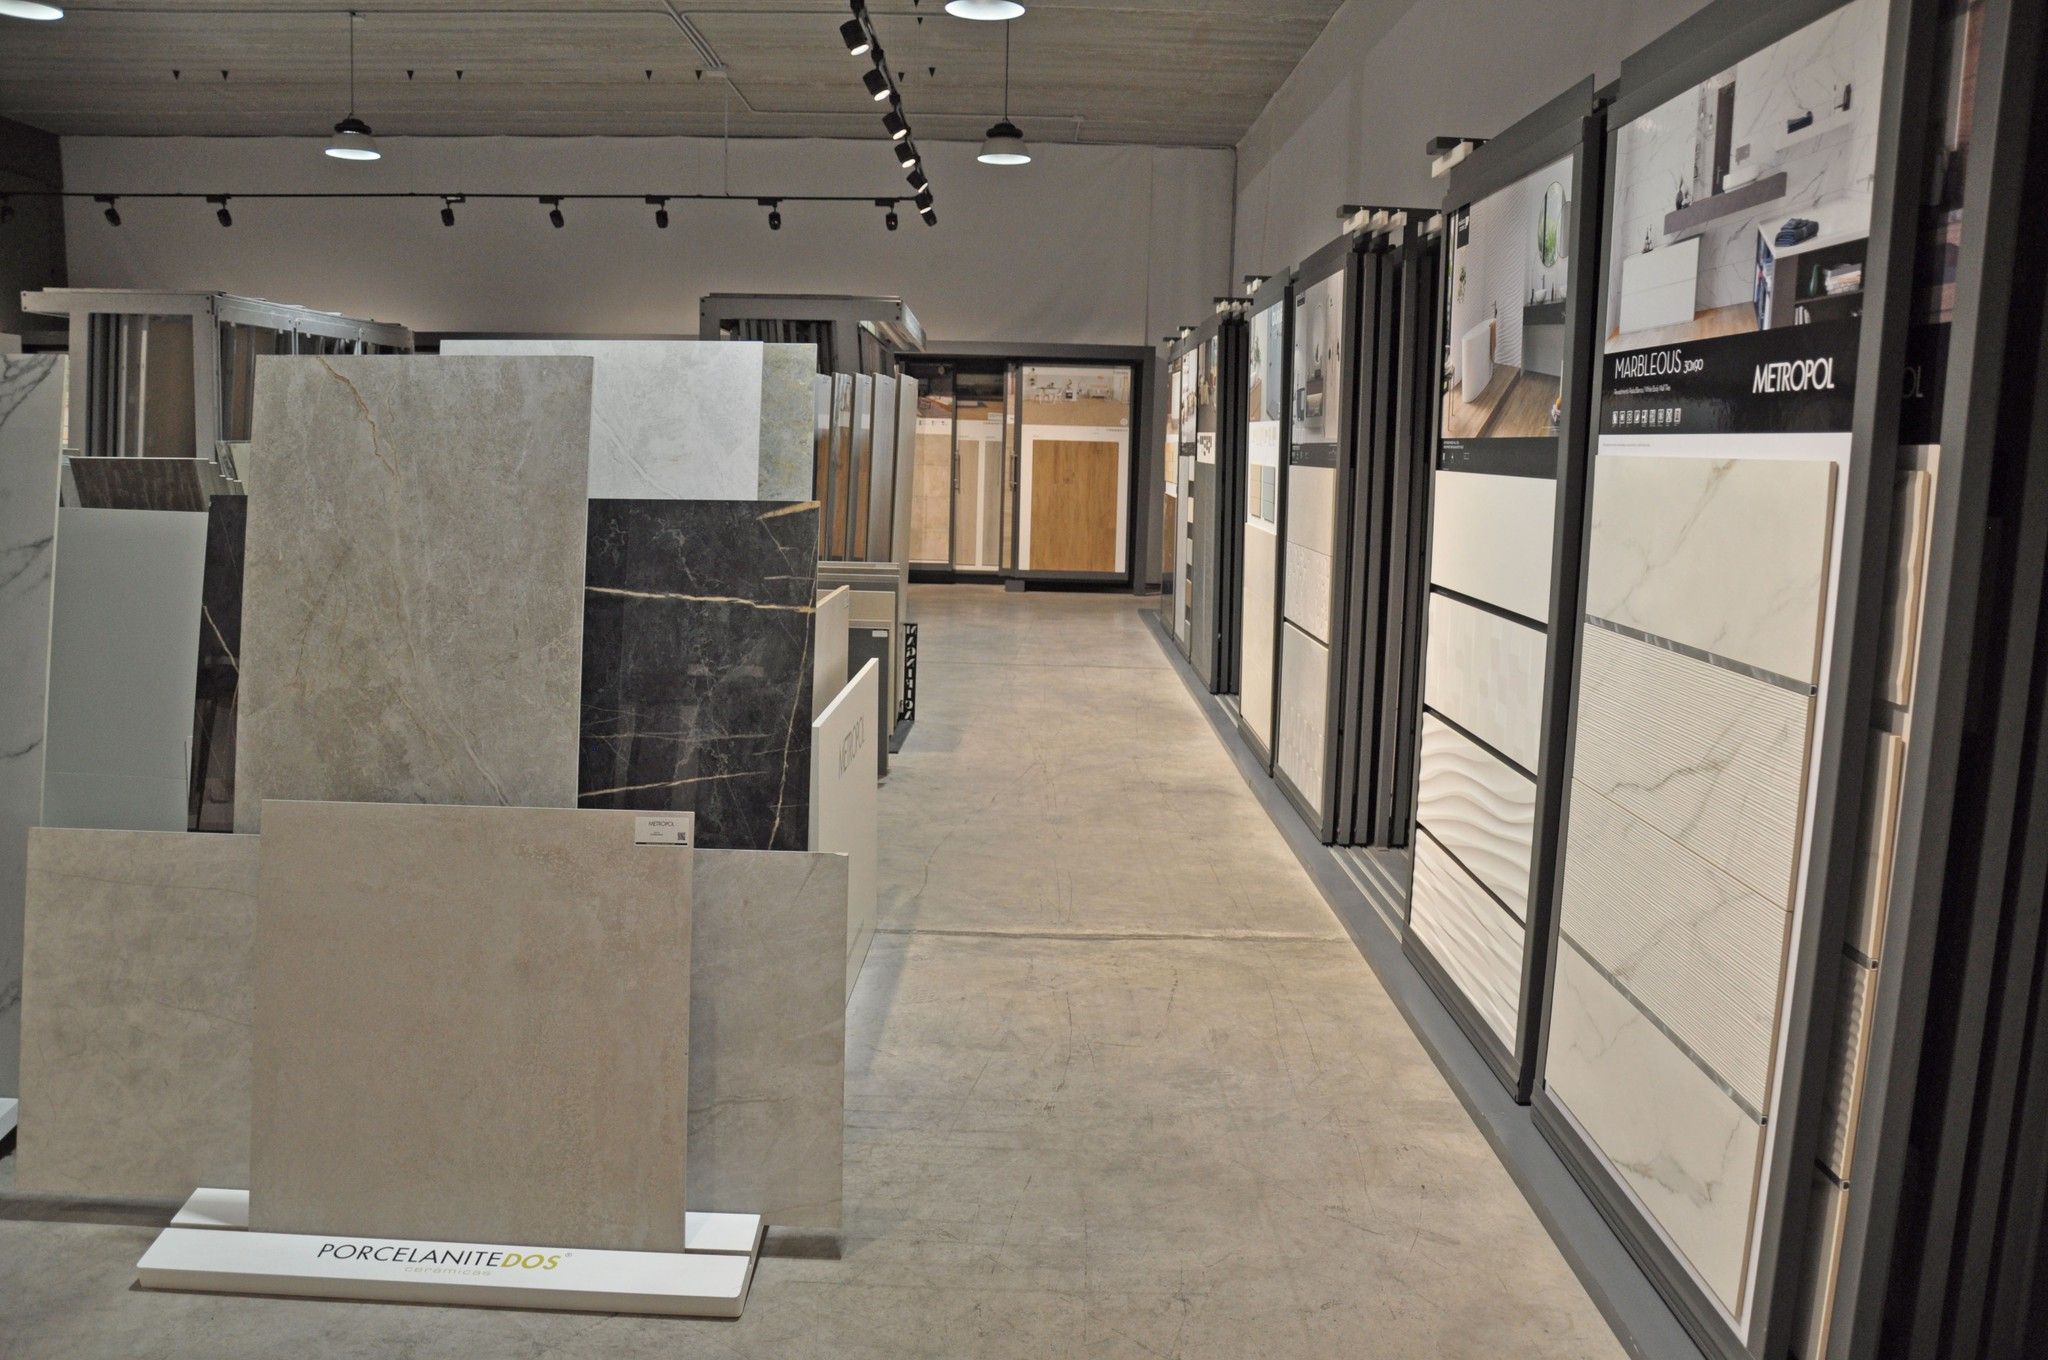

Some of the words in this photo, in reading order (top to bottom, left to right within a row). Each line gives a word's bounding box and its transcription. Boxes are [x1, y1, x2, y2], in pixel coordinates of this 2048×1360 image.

[1614, 350, 1682, 379] MARBLEOUS
[1752, 357, 1835, 394] METROPOL
[838, 715, 864, 778] METROPOL
